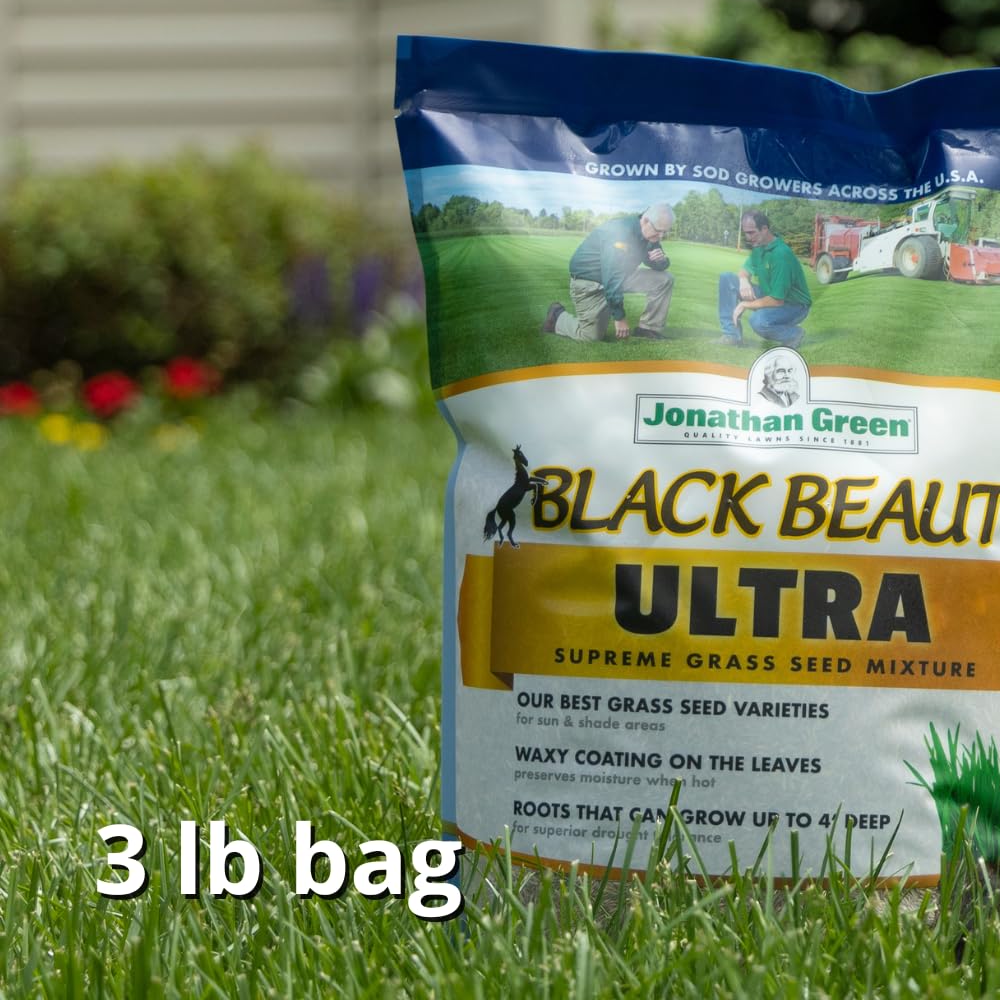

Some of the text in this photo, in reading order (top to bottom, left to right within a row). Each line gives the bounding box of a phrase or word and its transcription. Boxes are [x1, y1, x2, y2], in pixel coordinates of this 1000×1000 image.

[585, 161, 985, 201] GROWN BY SOD GROWERS ACROSS THE U.S.A.
[643, 402, 909, 437] Jonathan Green
[683, 431, 739, 441] QUALITY
[747, 435, 791, 443] LAWNS
[798, 436, 836, 444] SINCE
[530, 465, 769, 538] BLACK
[614, 563, 931, 643] ULTRA
[554, 647, 976, 678] SUPREME GRASS SEED MIXTURE
[517, 692, 830, 719] OUR BEST GRASS SEED VARIETIES
[516, 712, 666, 731] for sun & shade areas
[515, 746, 822, 773] WAXY COATING ON THE LEAVES
[514, 769, 717, 788] preserves moisture when hot
[513, 800, 571, 819] ROOTS
[576, 804, 623, 822] THAT
[629, 807, 671, 824] CAN
[680, 809, 746, 827] GROW
[753, 812, 780, 828] UP
[785, 812, 812, 828] TO
[844, 814, 891, 830] DEEP
[512, 820, 529, 833] for
[533, 824, 588, 839] superior
